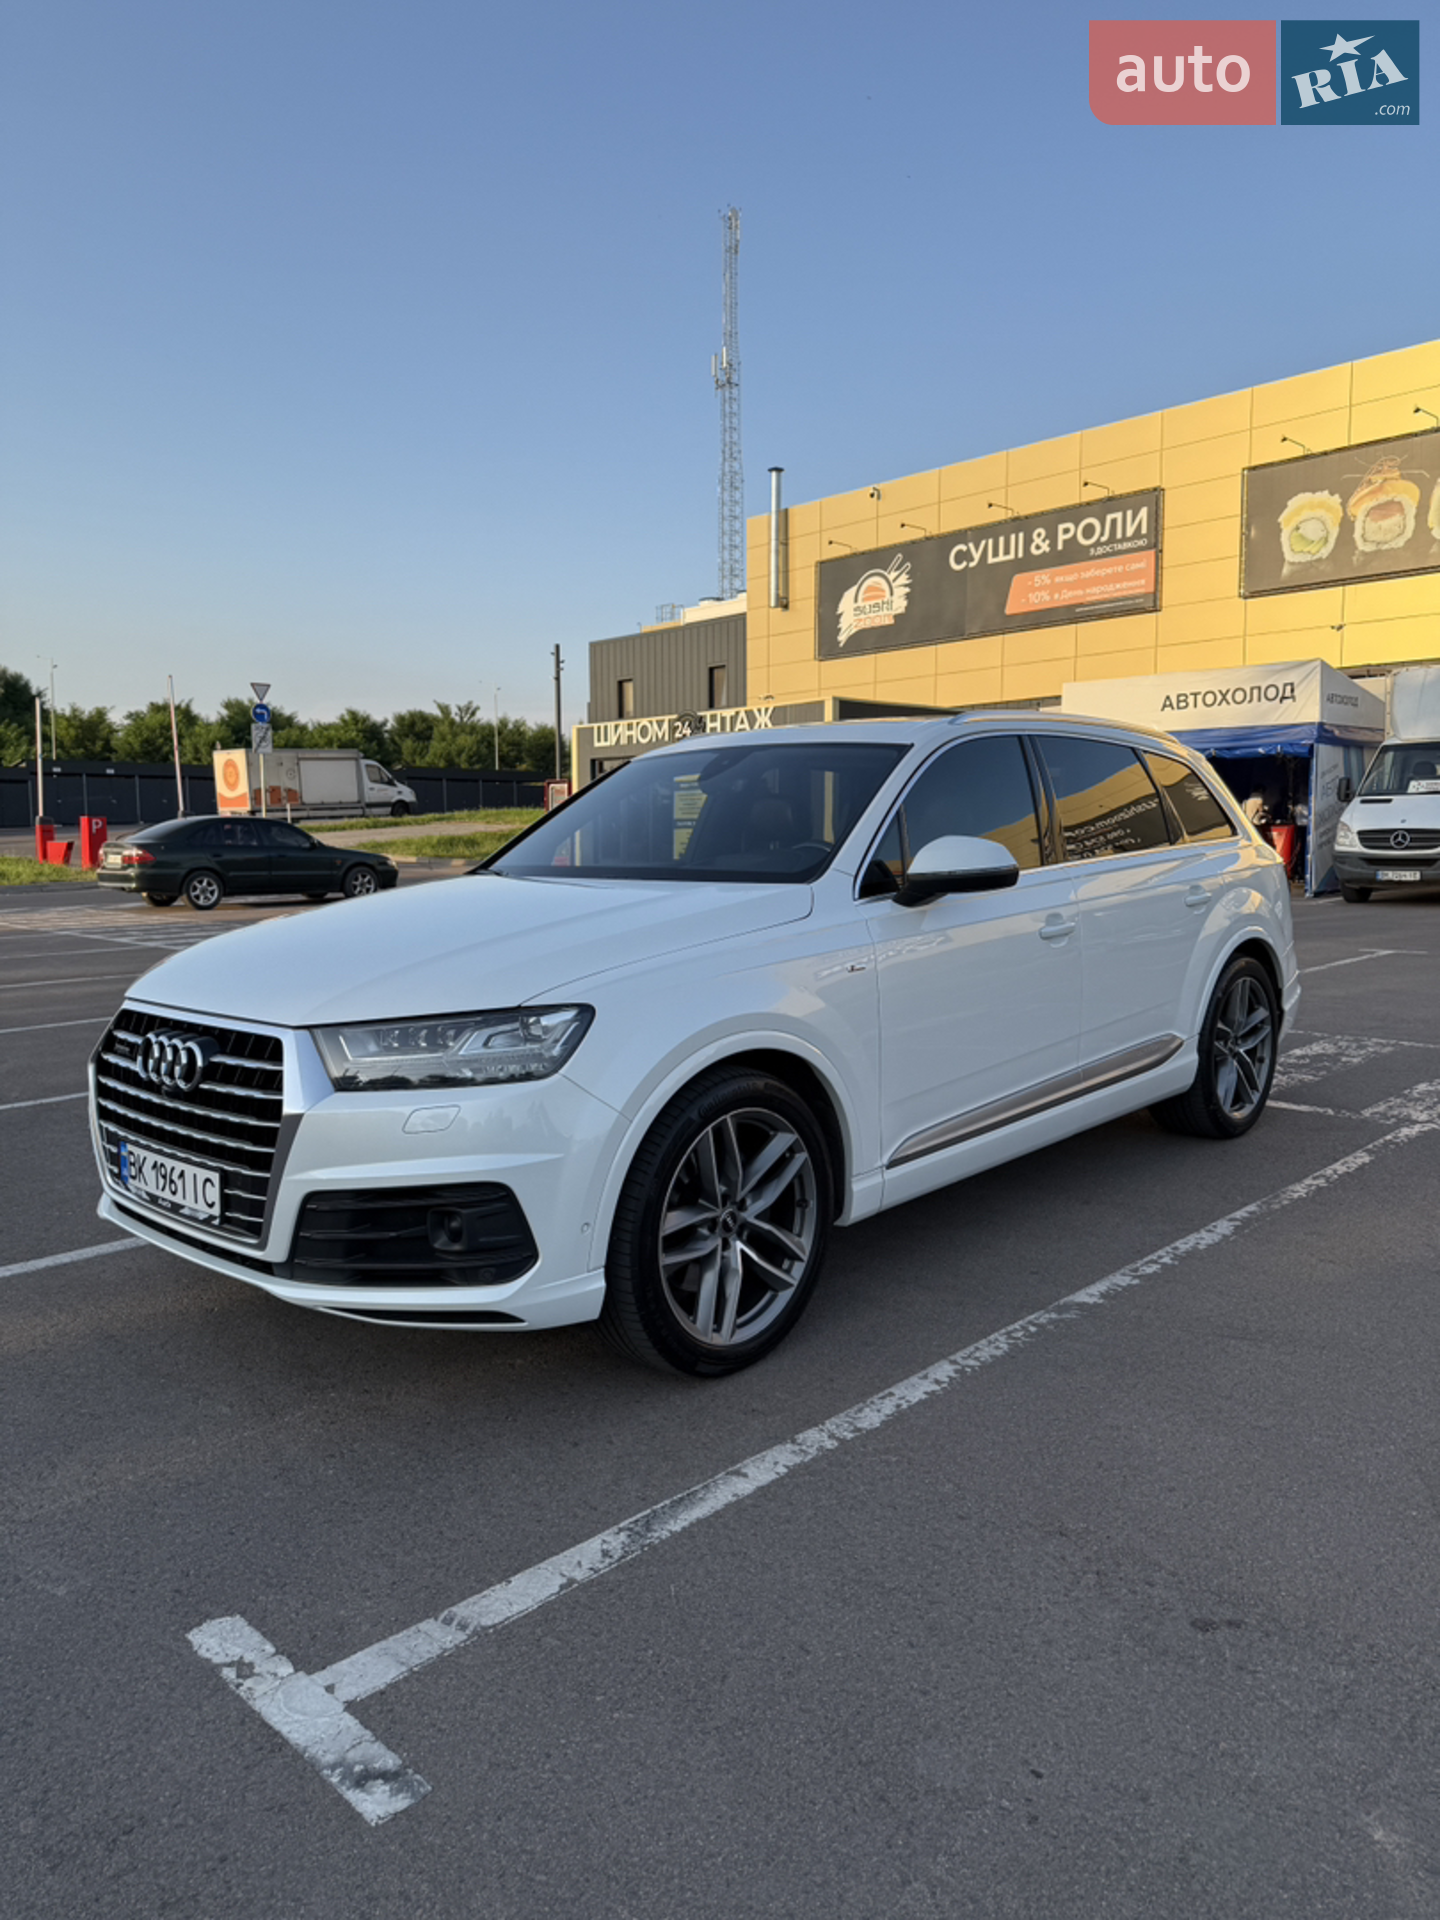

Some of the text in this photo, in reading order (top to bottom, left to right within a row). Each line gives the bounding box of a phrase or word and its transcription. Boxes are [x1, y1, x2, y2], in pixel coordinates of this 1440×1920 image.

[949, 506, 1149, 571] СУШІ & РОЛИ
[1161, 682, 1296, 711] АВТОХОЛОД
[92, 819, 103, 834] P
[151, 1160, 186, 1201] 1961
